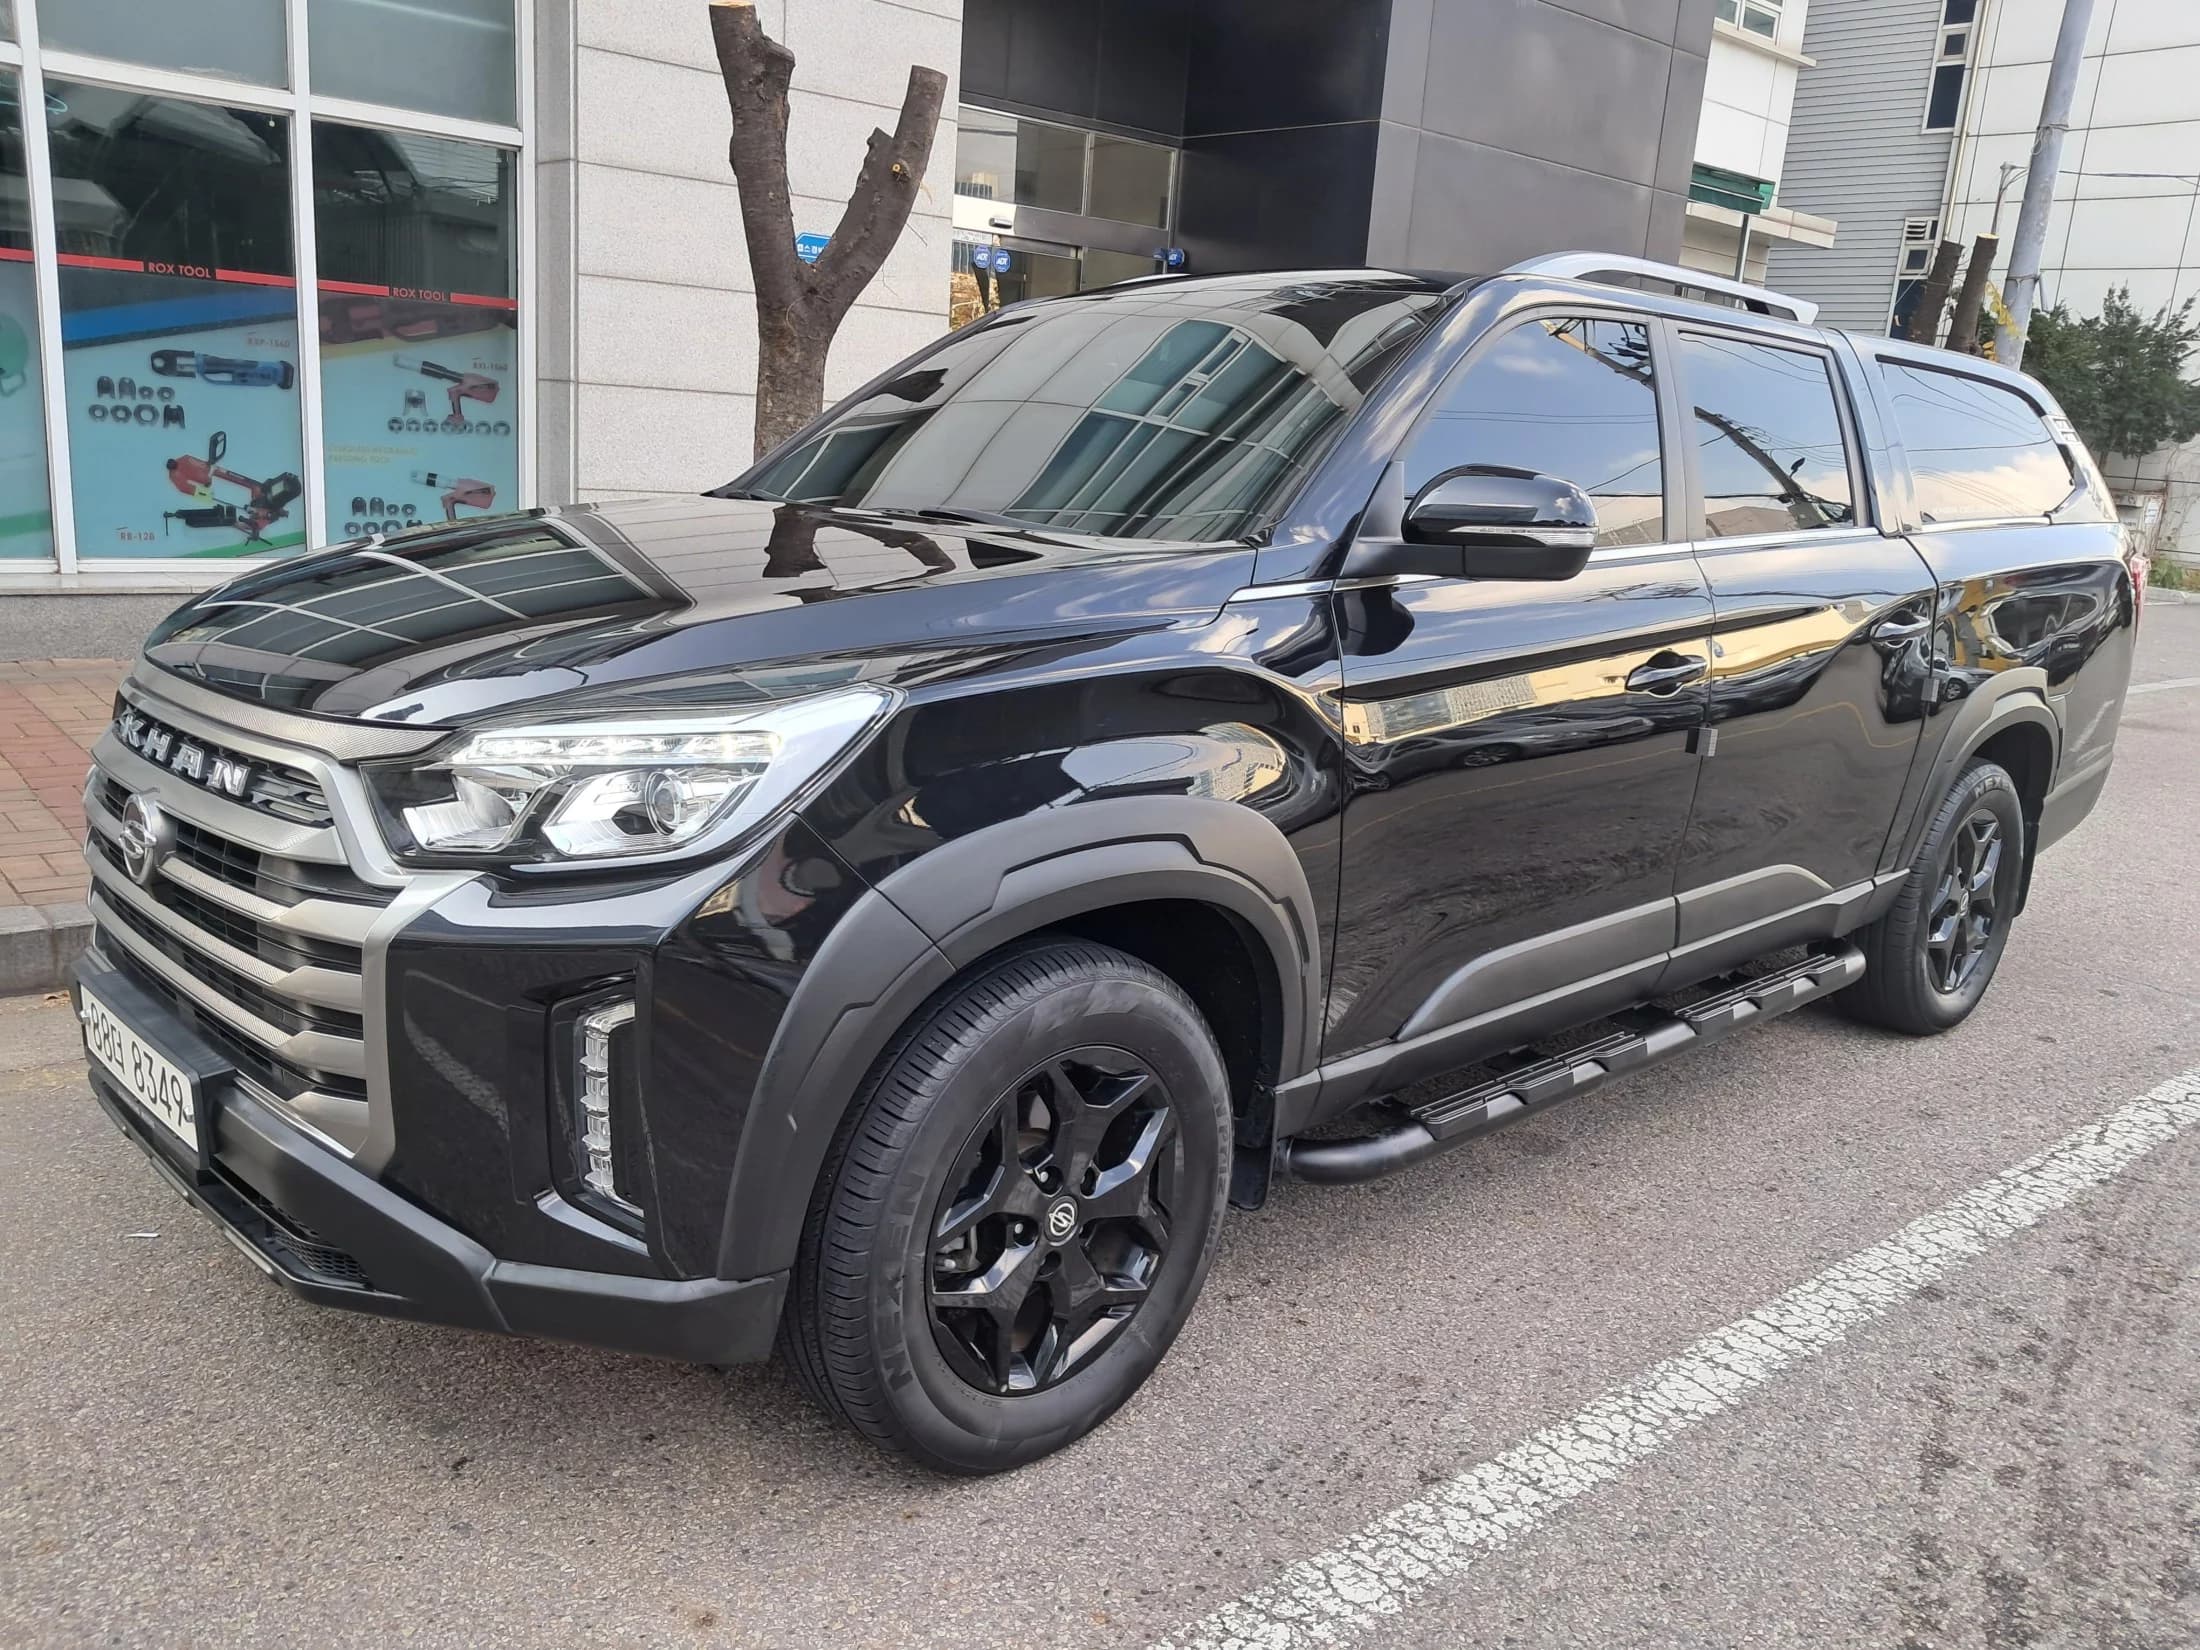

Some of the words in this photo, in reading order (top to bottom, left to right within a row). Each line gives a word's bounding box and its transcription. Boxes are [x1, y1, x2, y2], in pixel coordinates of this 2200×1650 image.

[976, 252, 989, 261] ADT
[995, 257, 1009, 265] ADT
[148, 261, 175, 275] ROX
[178, 264, 212, 279] TOOL
[392, 286, 417, 299] ROX
[419, 289, 447, 302] TOOL
[120, 708, 251, 797] KHAN
[90, 1002, 126, 1075] 88더
[131, 1041, 184, 1127] 8349
